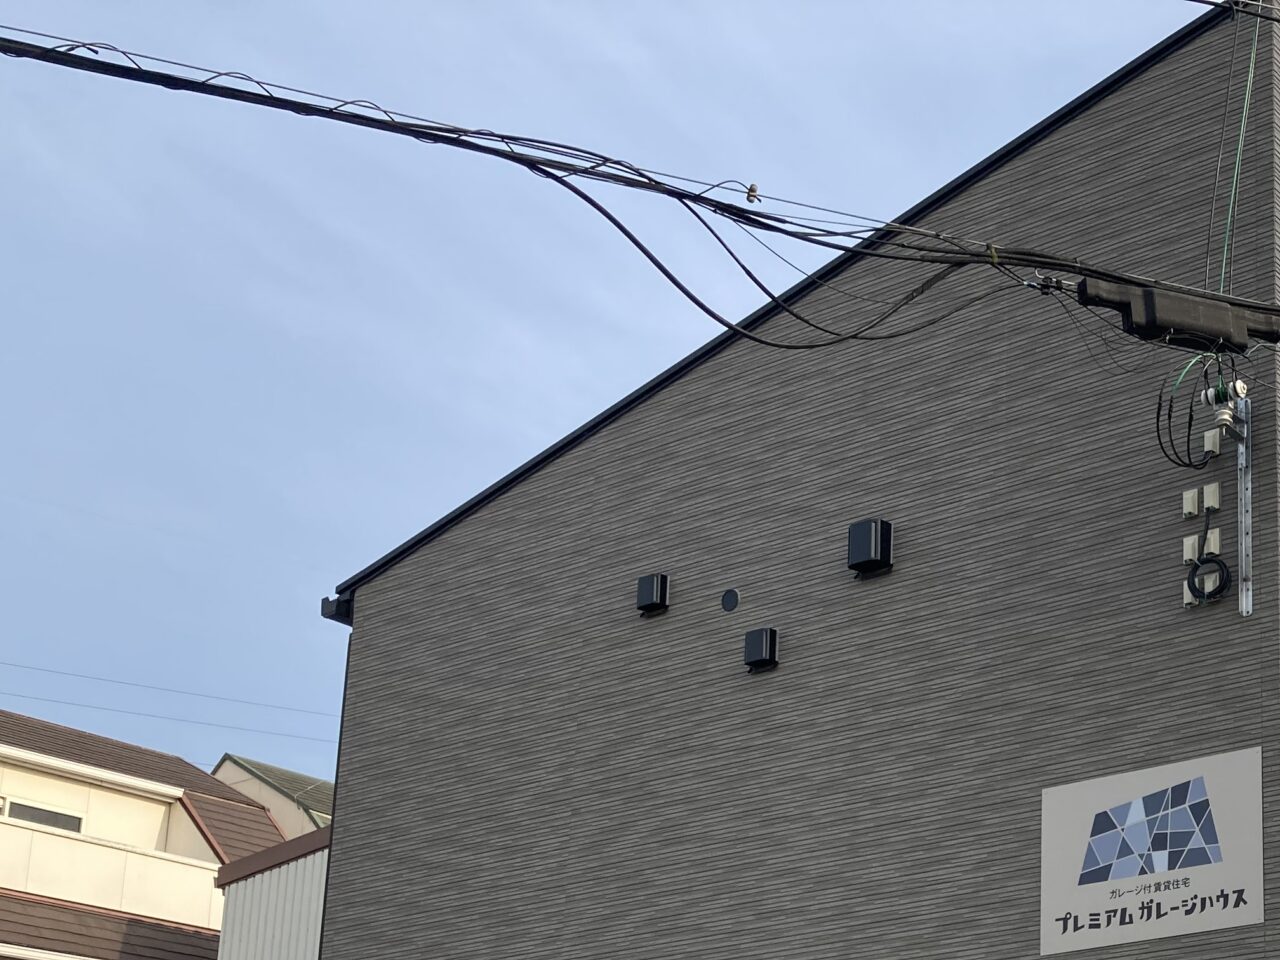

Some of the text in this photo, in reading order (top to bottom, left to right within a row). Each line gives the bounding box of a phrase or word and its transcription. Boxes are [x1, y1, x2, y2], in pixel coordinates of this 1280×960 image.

[1109, 877, 1191, 899] ガレージ付賃貸住宅
